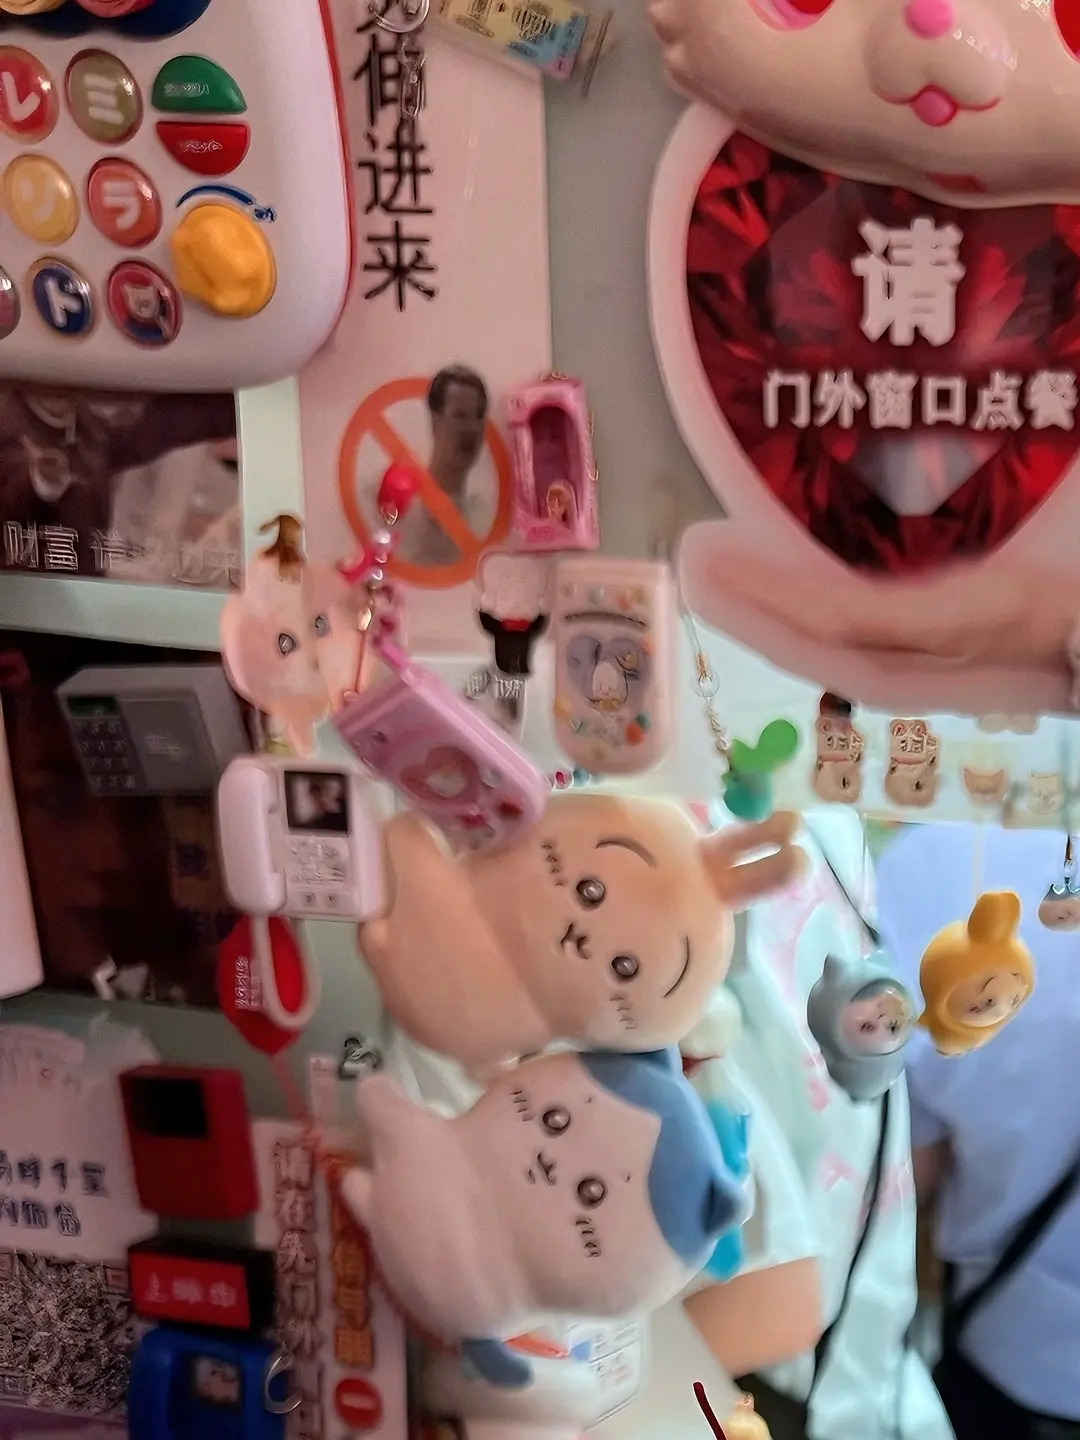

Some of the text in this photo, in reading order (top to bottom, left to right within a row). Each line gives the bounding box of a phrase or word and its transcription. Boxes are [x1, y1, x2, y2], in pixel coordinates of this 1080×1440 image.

[852, 216, 966, 347] 请
[762, 369, 1080, 432] 门外窗口点餐
